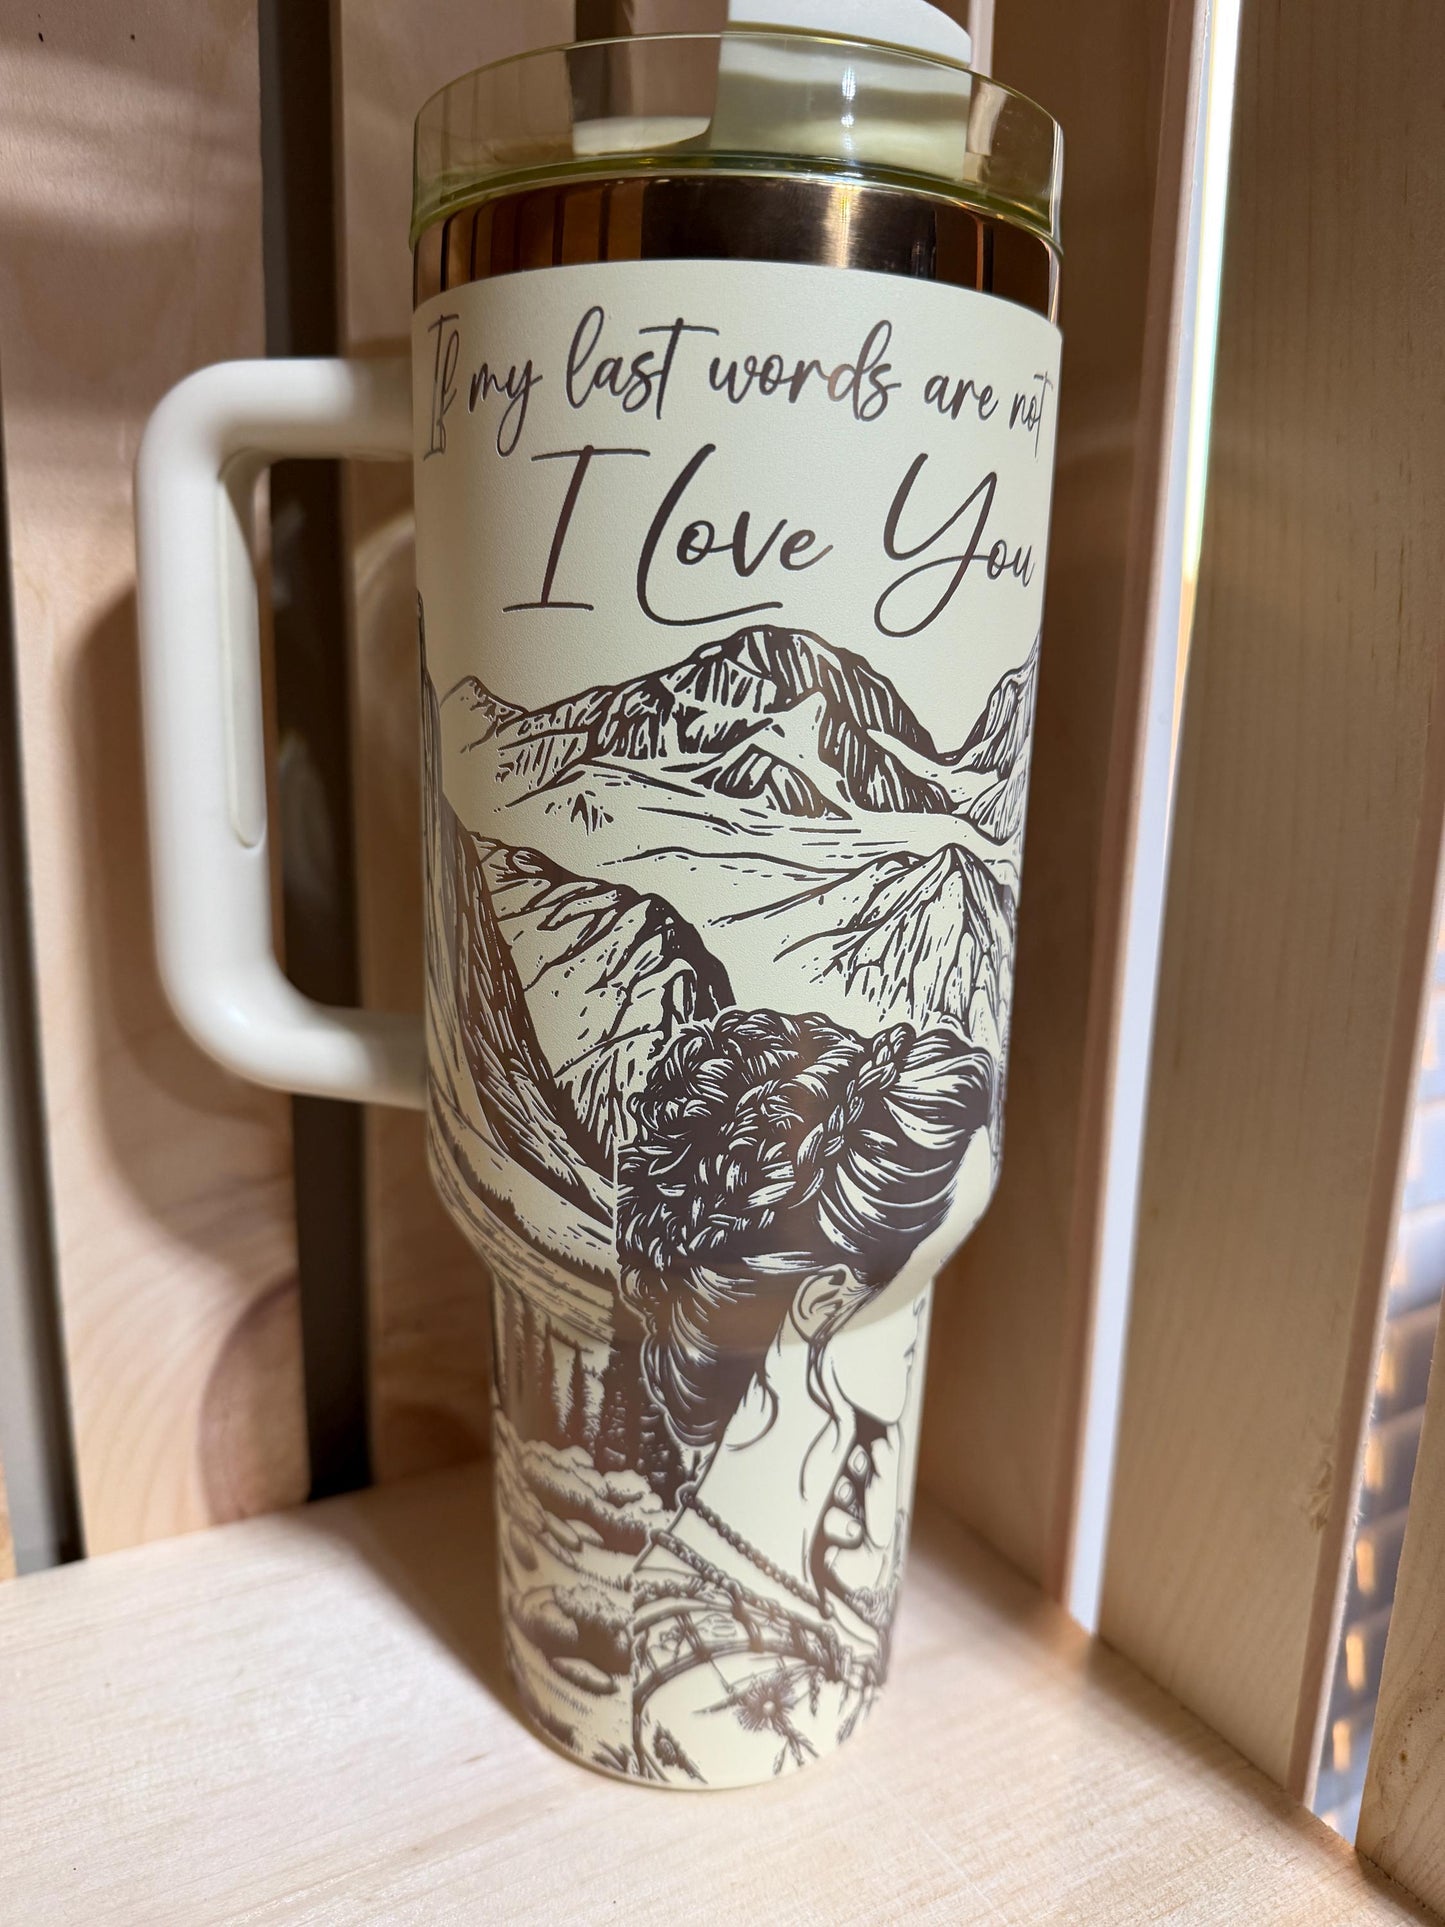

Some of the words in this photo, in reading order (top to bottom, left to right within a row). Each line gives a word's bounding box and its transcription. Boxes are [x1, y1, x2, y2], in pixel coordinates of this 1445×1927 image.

[424, 314, 460, 461] If
[468, 359, 544, 458] my
[565, 305, 720, 421] last
[708, 319, 903, 422] words
[923, 374, 999, 421] are
[1008, 371, 1054, 459] not
[502, 444, 651, 613] I
[636, 443, 834, 627] Love
[873, 452, 1037, 638] You
